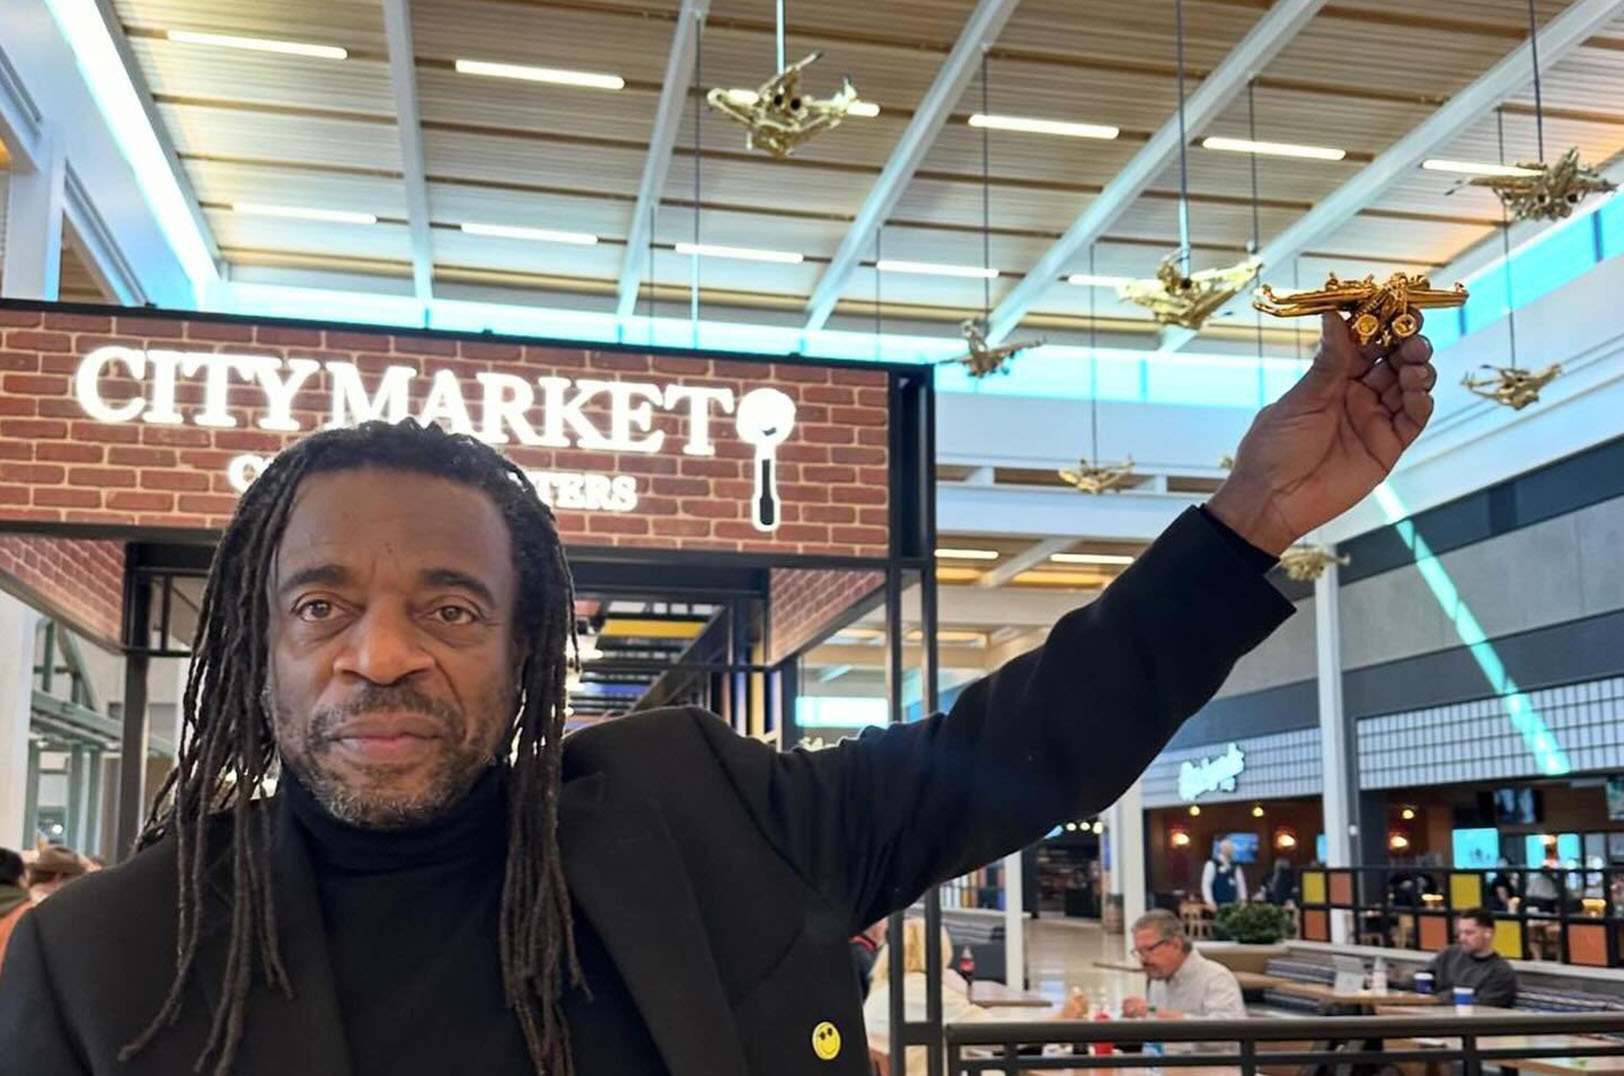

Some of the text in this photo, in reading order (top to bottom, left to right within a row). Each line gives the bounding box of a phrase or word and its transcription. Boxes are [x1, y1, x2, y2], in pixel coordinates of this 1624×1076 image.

[76, 345, 735, 456] CITY MARKET
[518, 470, 639, 512] TERS
